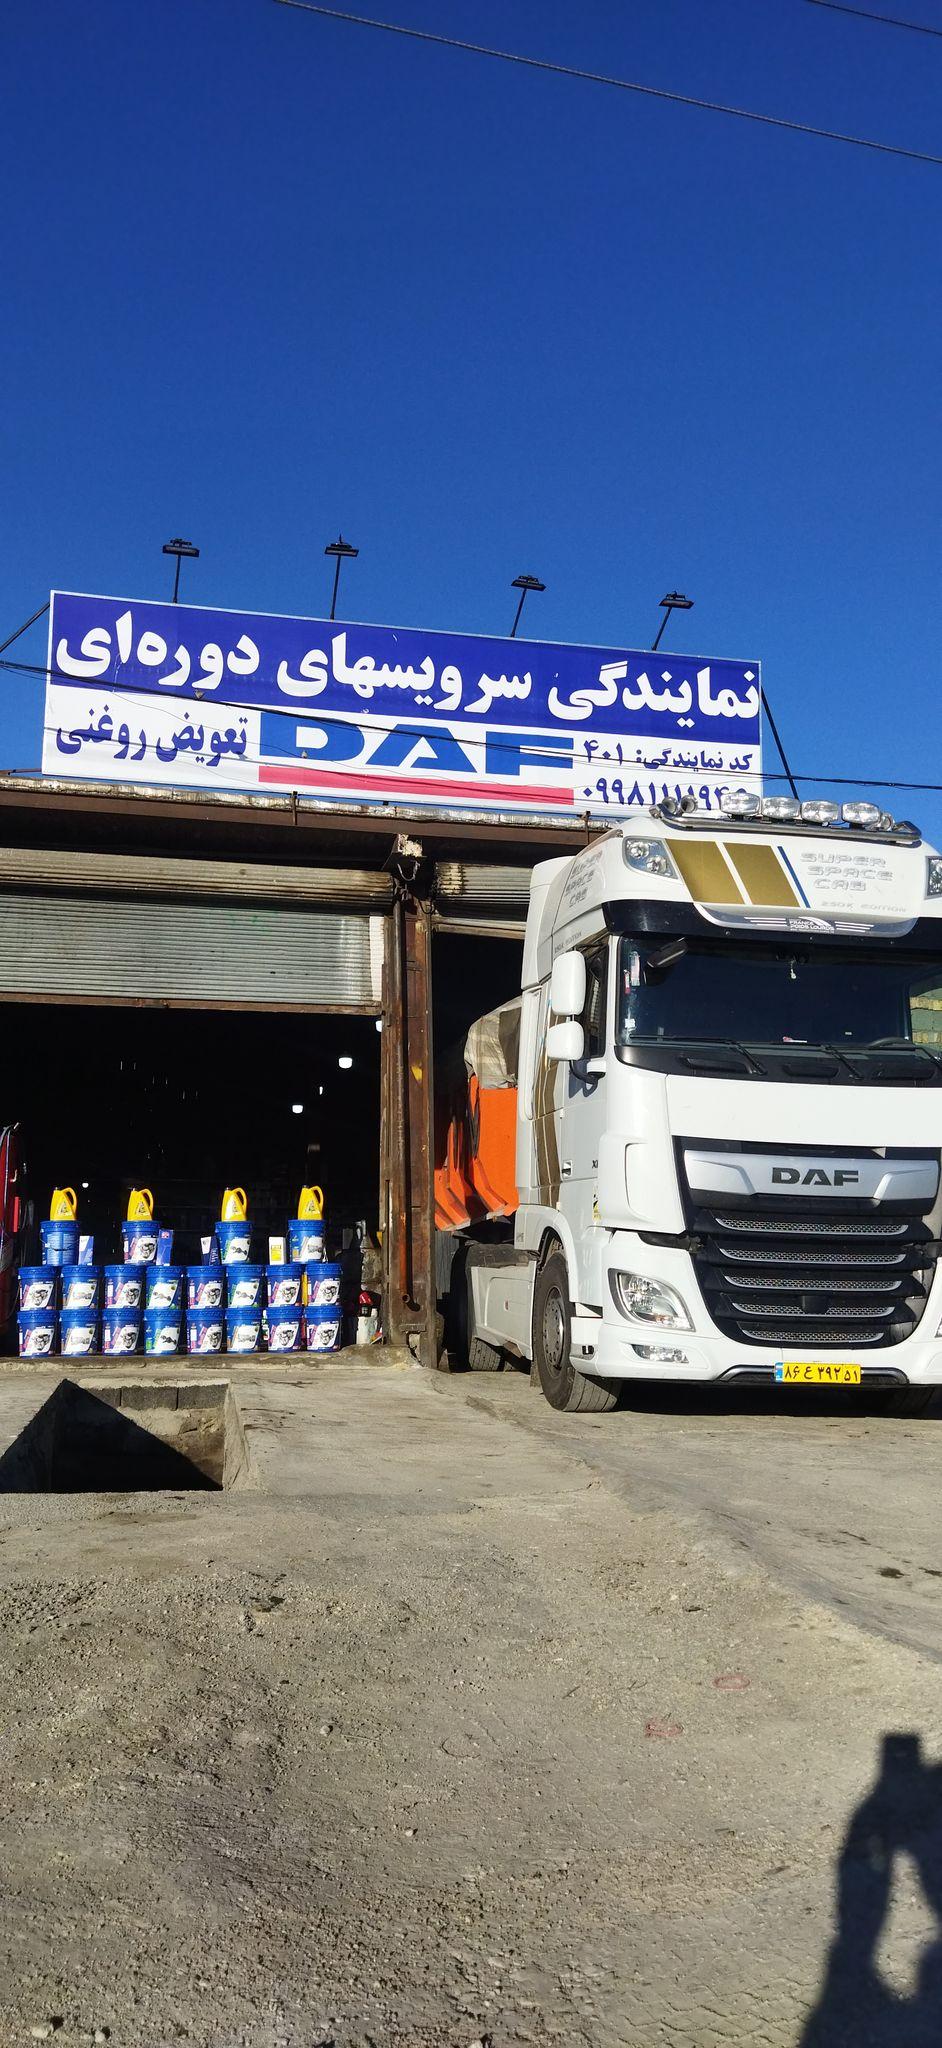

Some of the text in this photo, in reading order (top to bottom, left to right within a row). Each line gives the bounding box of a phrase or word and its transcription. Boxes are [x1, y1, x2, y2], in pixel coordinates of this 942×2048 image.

[277, 631, 532, 714] سرویسهای
[548, 660, 760, 728] نمایندگی
[56, 704, 248, 767] تعویض روغنی
[260, 712, 574, 776] DAF
[583, 739, 753, 772] کد نمایندگی: ۴۰۱
[801, 852, 887, 868] SUPER
[808, 865, 893, 881] SPACE
[814, 878, 867, 891] CAB
[860, 903, 908, 912] EDITION
[772, 1167, 858, 1186] DAF
